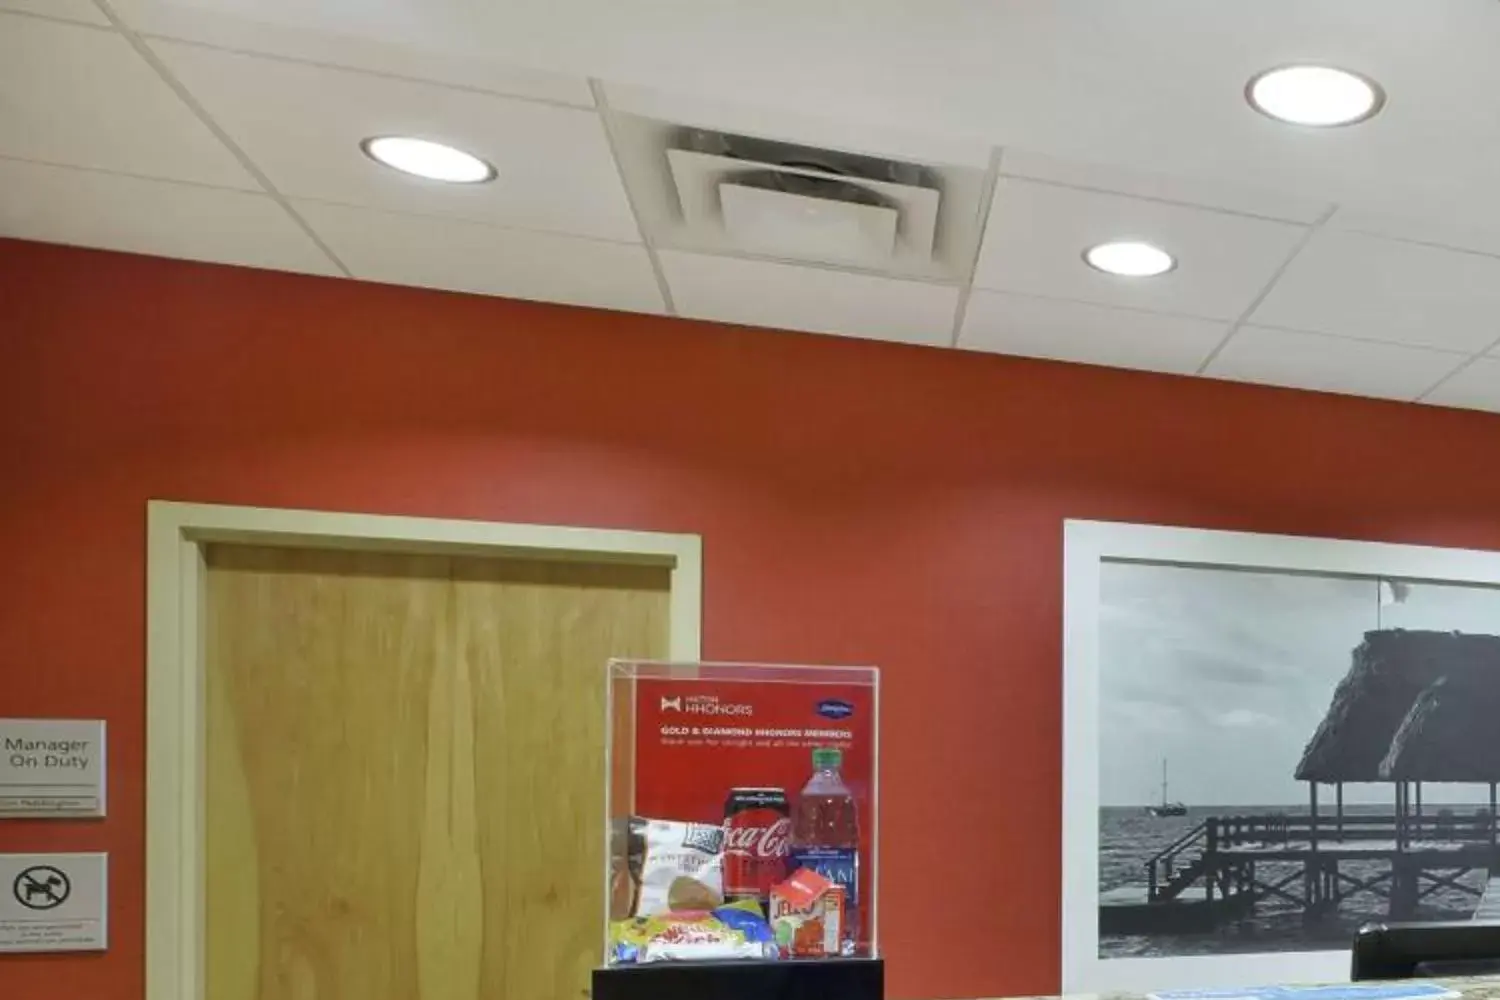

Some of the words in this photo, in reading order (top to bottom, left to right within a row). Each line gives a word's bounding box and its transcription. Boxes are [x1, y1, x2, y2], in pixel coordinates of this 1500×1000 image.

[5, 737, 89, 755] Manager
[9, 754, 38, 768] On
[44, 755, 89, 771] Duty
